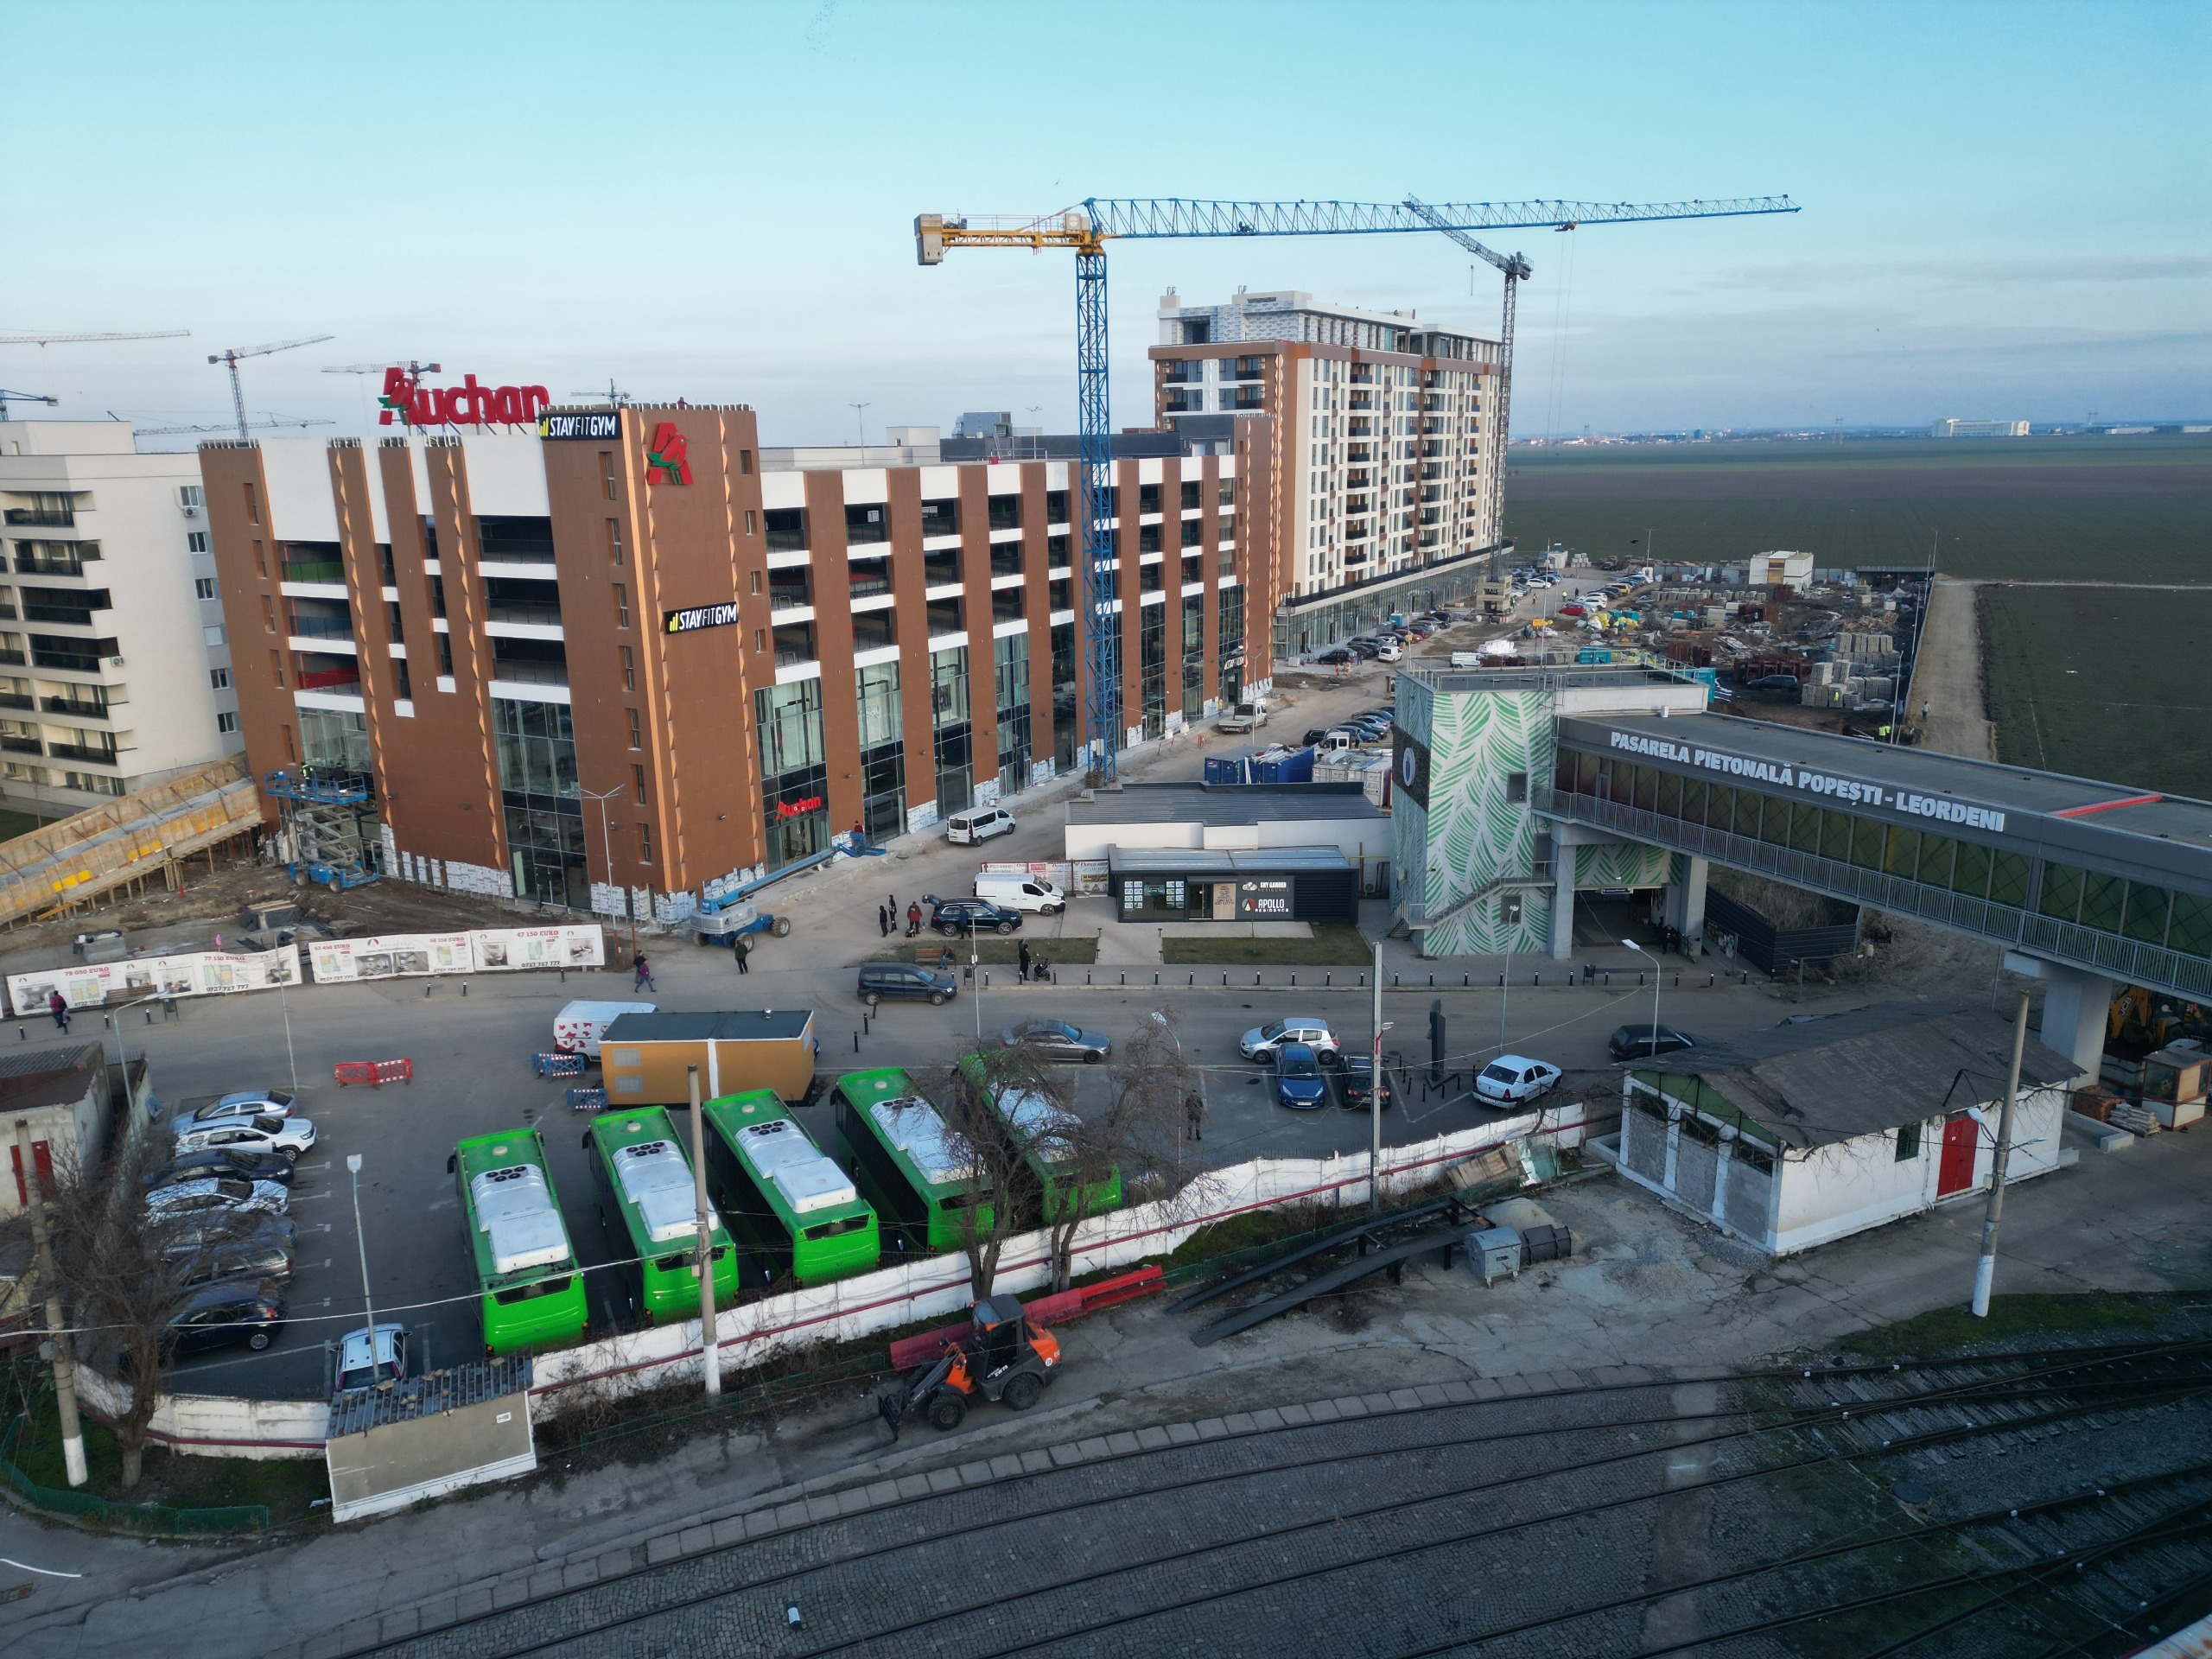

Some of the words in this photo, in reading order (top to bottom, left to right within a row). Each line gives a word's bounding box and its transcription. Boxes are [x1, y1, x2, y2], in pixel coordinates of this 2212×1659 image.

[378, 367, 550, 425] Auchan
[1611, 732, 1690, 763] PASARELA
[1694, 749, 1793, 786] PIETONALĂ
[1896, 791, 2005, 832] LEORDENI
[1258, 899, 1285, 908] APOLLO
[2120, 995, 2133, 1016] JCB
